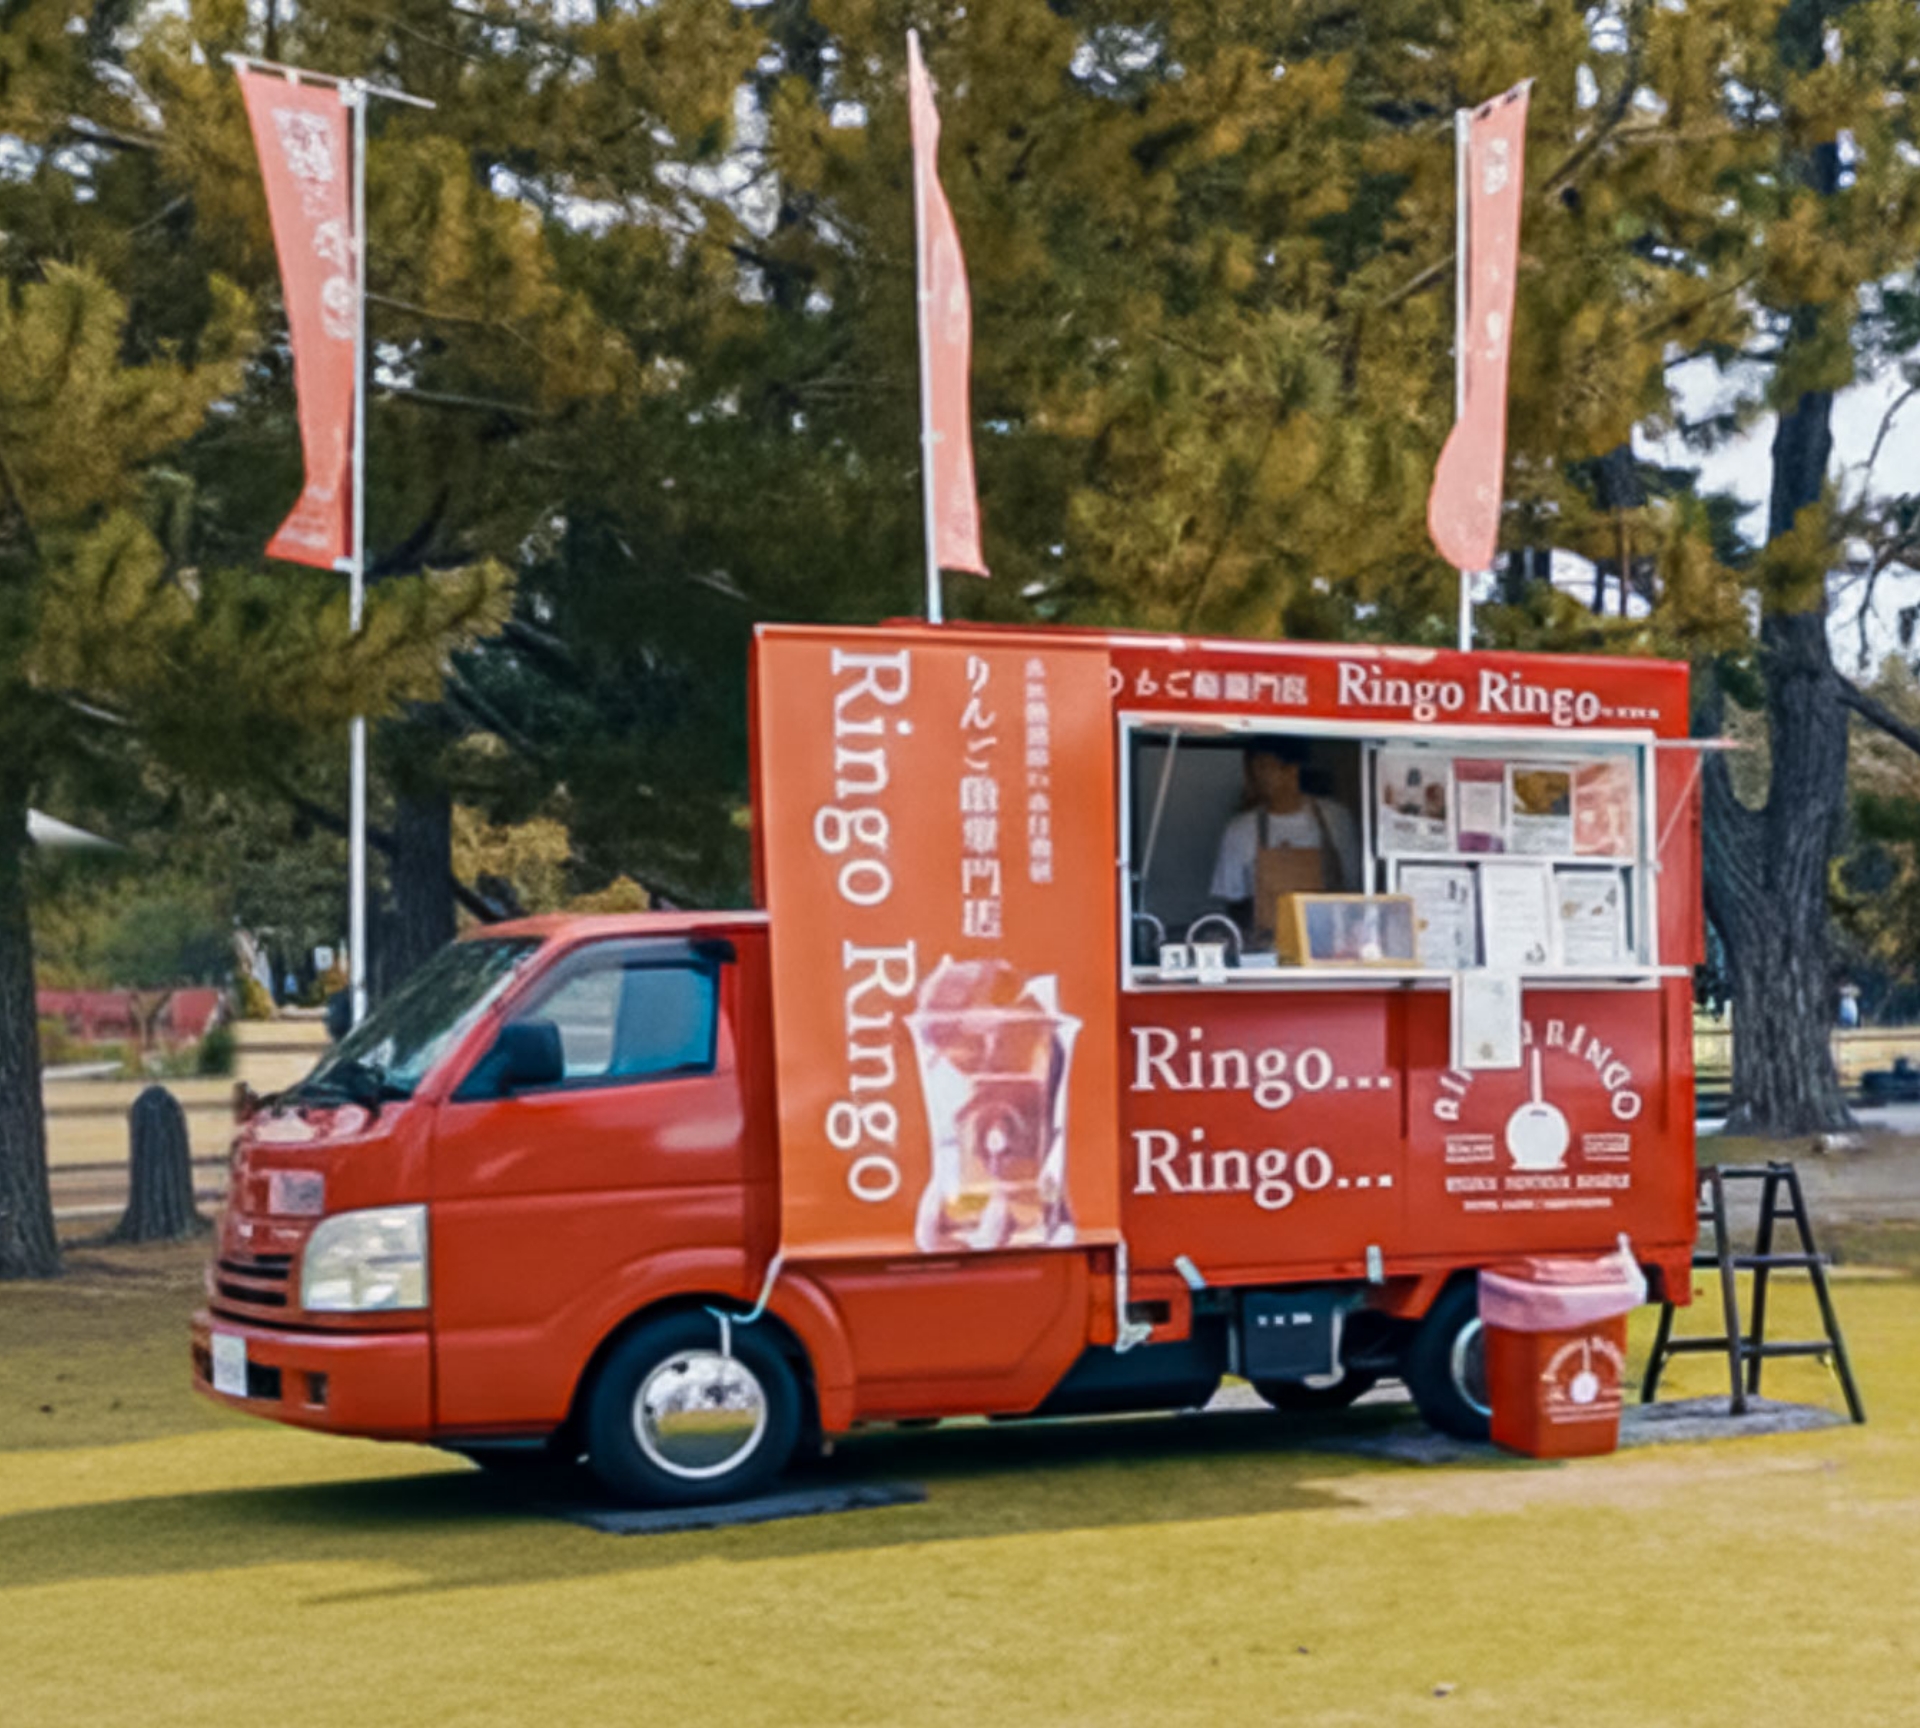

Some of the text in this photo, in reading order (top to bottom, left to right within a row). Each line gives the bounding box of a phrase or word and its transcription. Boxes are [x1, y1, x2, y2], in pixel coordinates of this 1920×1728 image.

[1338, 661, 1464, 722] Ringo
[815, 648, 919, 1203] Ringo Ringo
[1546, 1019, 1642, 1121] RINGO
